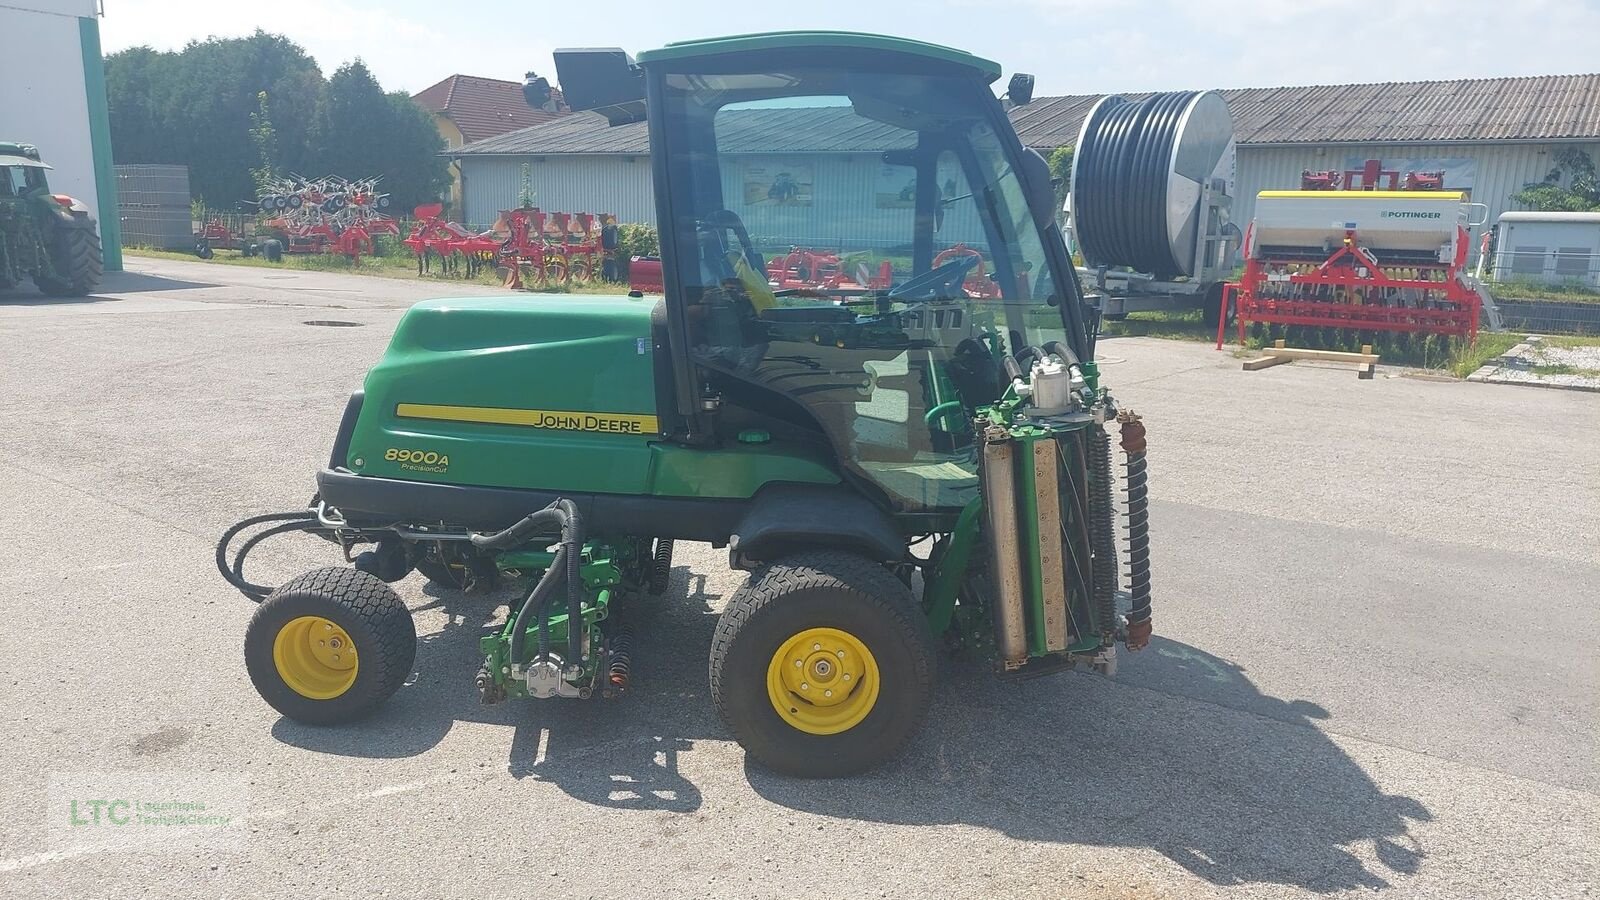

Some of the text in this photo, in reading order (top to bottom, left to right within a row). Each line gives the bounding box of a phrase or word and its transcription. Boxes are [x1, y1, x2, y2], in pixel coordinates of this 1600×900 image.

[534, 413, 641, 432] JOHN DEERE
[384, 448, 449, 466] 8900A
[401, 463, 447, 473] PrecisionCut
